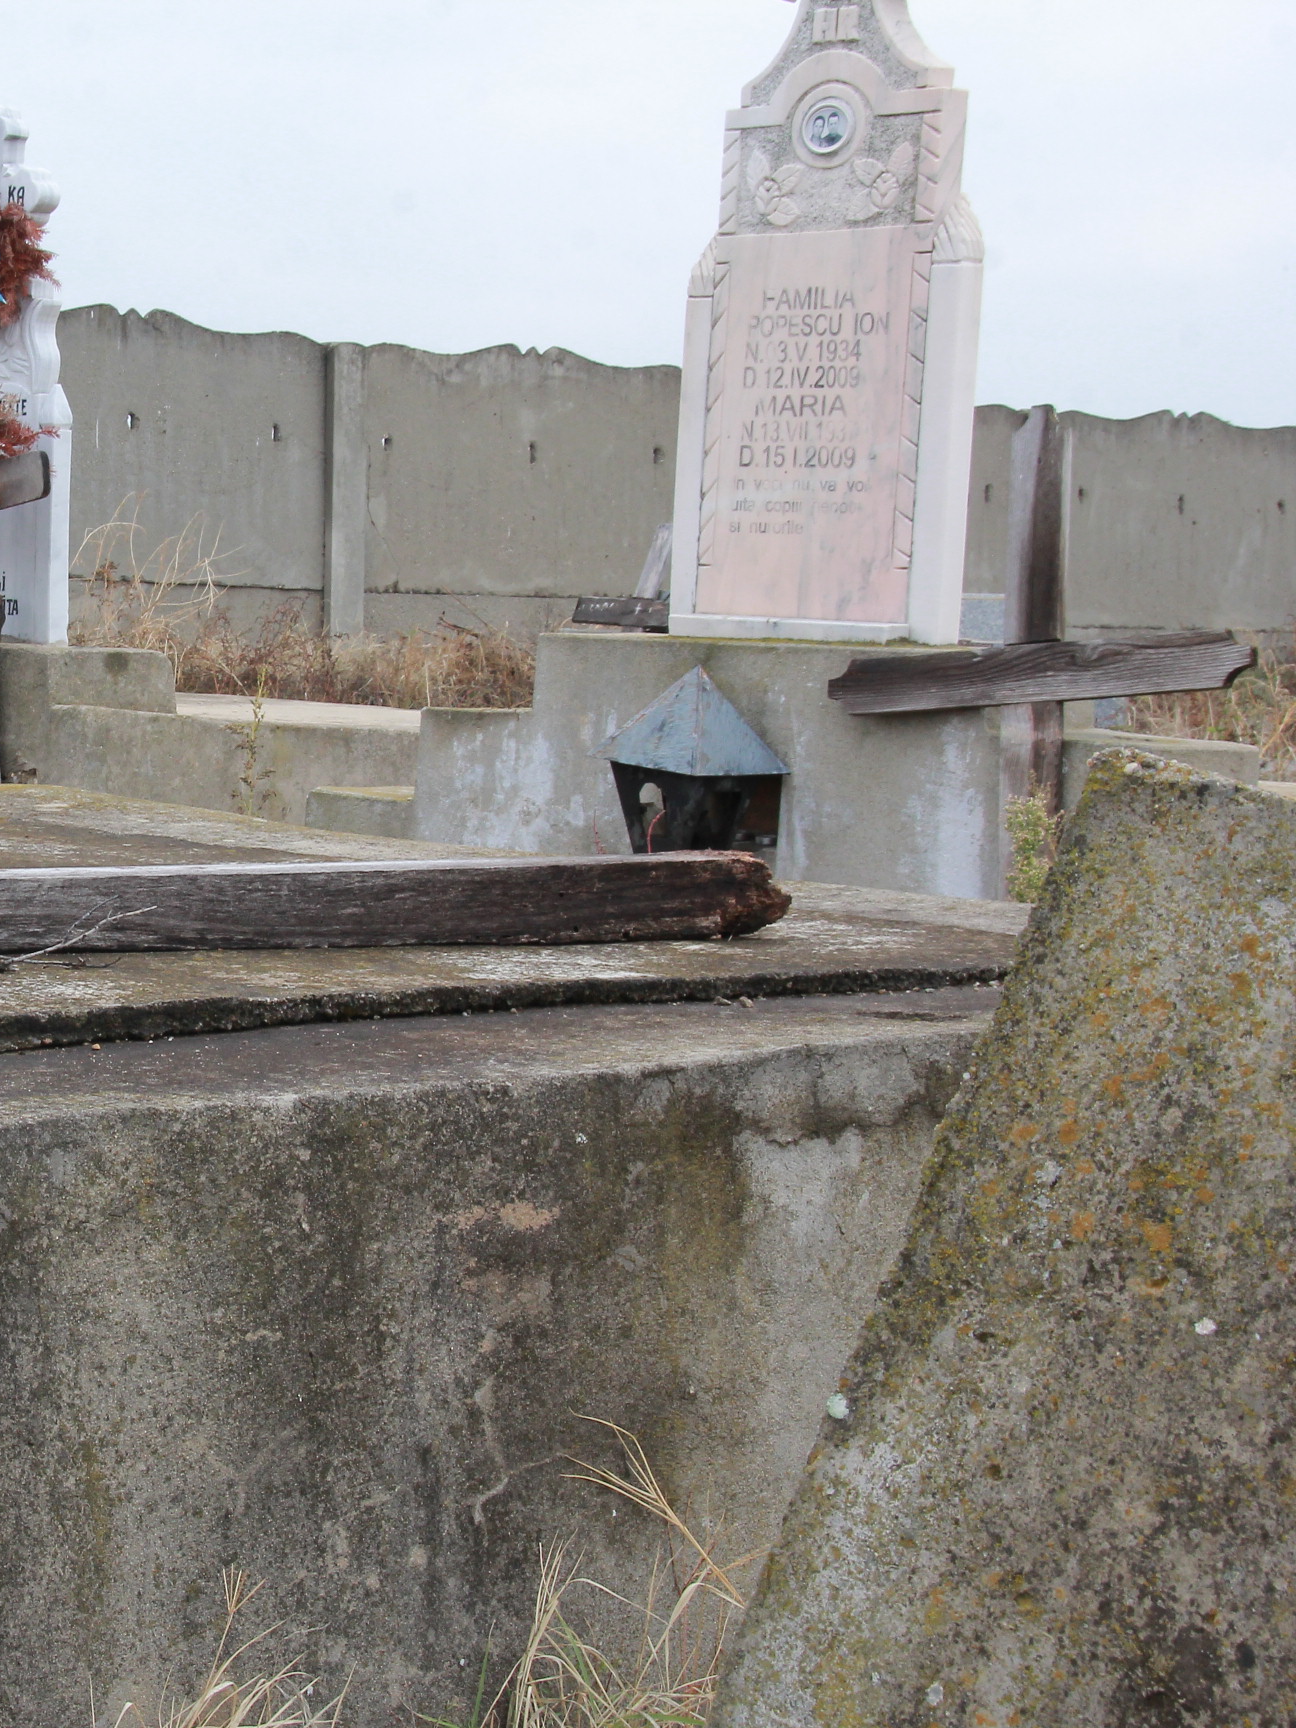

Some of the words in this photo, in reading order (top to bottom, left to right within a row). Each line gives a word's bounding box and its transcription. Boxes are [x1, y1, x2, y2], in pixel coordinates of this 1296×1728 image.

[8, 185, 25, 206] KA
[762, 286, 856, 311] FAMILIA
[748, 313, 843, 338] POPESCU
[854, 311, 890, 336] ION
[755, 394, 847, 418] MARIA
[820, 479, 837, 492] va
